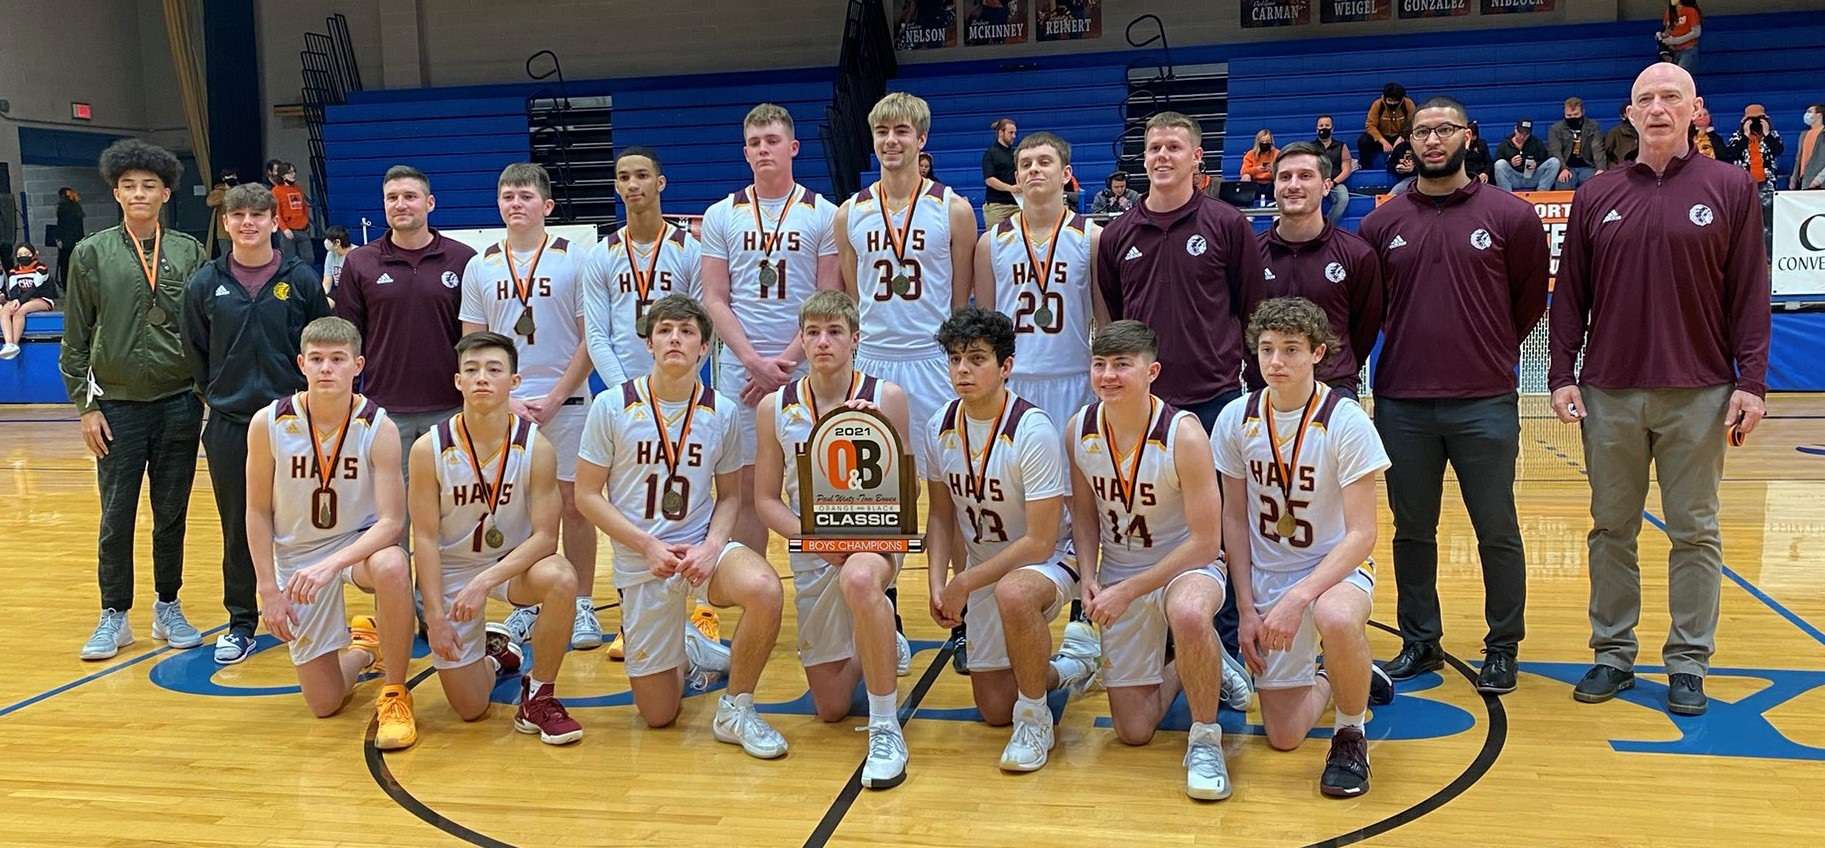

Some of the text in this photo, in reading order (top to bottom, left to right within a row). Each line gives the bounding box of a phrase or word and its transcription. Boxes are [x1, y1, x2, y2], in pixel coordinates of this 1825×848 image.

[1251, 4, 1299, 21] CARMAN
[1334, 0, 1377, 16] WEIGEL
[1404, 0, 1465, 12] GONZALEZ
[905, 27, 946, 44] NELSON
[968, 23, 1024, 40] MCKINNEY
[1046, 18, 1092, 35] REINERT
[867, 228, 925, 252] HAS
[759, 258, 786, 299] 11
[873, 258, 922, 302] 33
[1013, 261, 1067, 285] HAS
[1014, 291, 1064, 334] 20
[835, 427, 871, 436] 2021
[645, 473, 690, 521] 10
[949, 472, 1004, 502] HAS
[1093, 476, 1156, 506] HAS
[312, 487, 337, 530] 0
[816, 513, 899, 526] CLASSIC
[472, 512, 489, 553] 1
[1259, 494, 1313, 549] 25
[808, 541, 902, 551] BOYS CHAMPIONS
